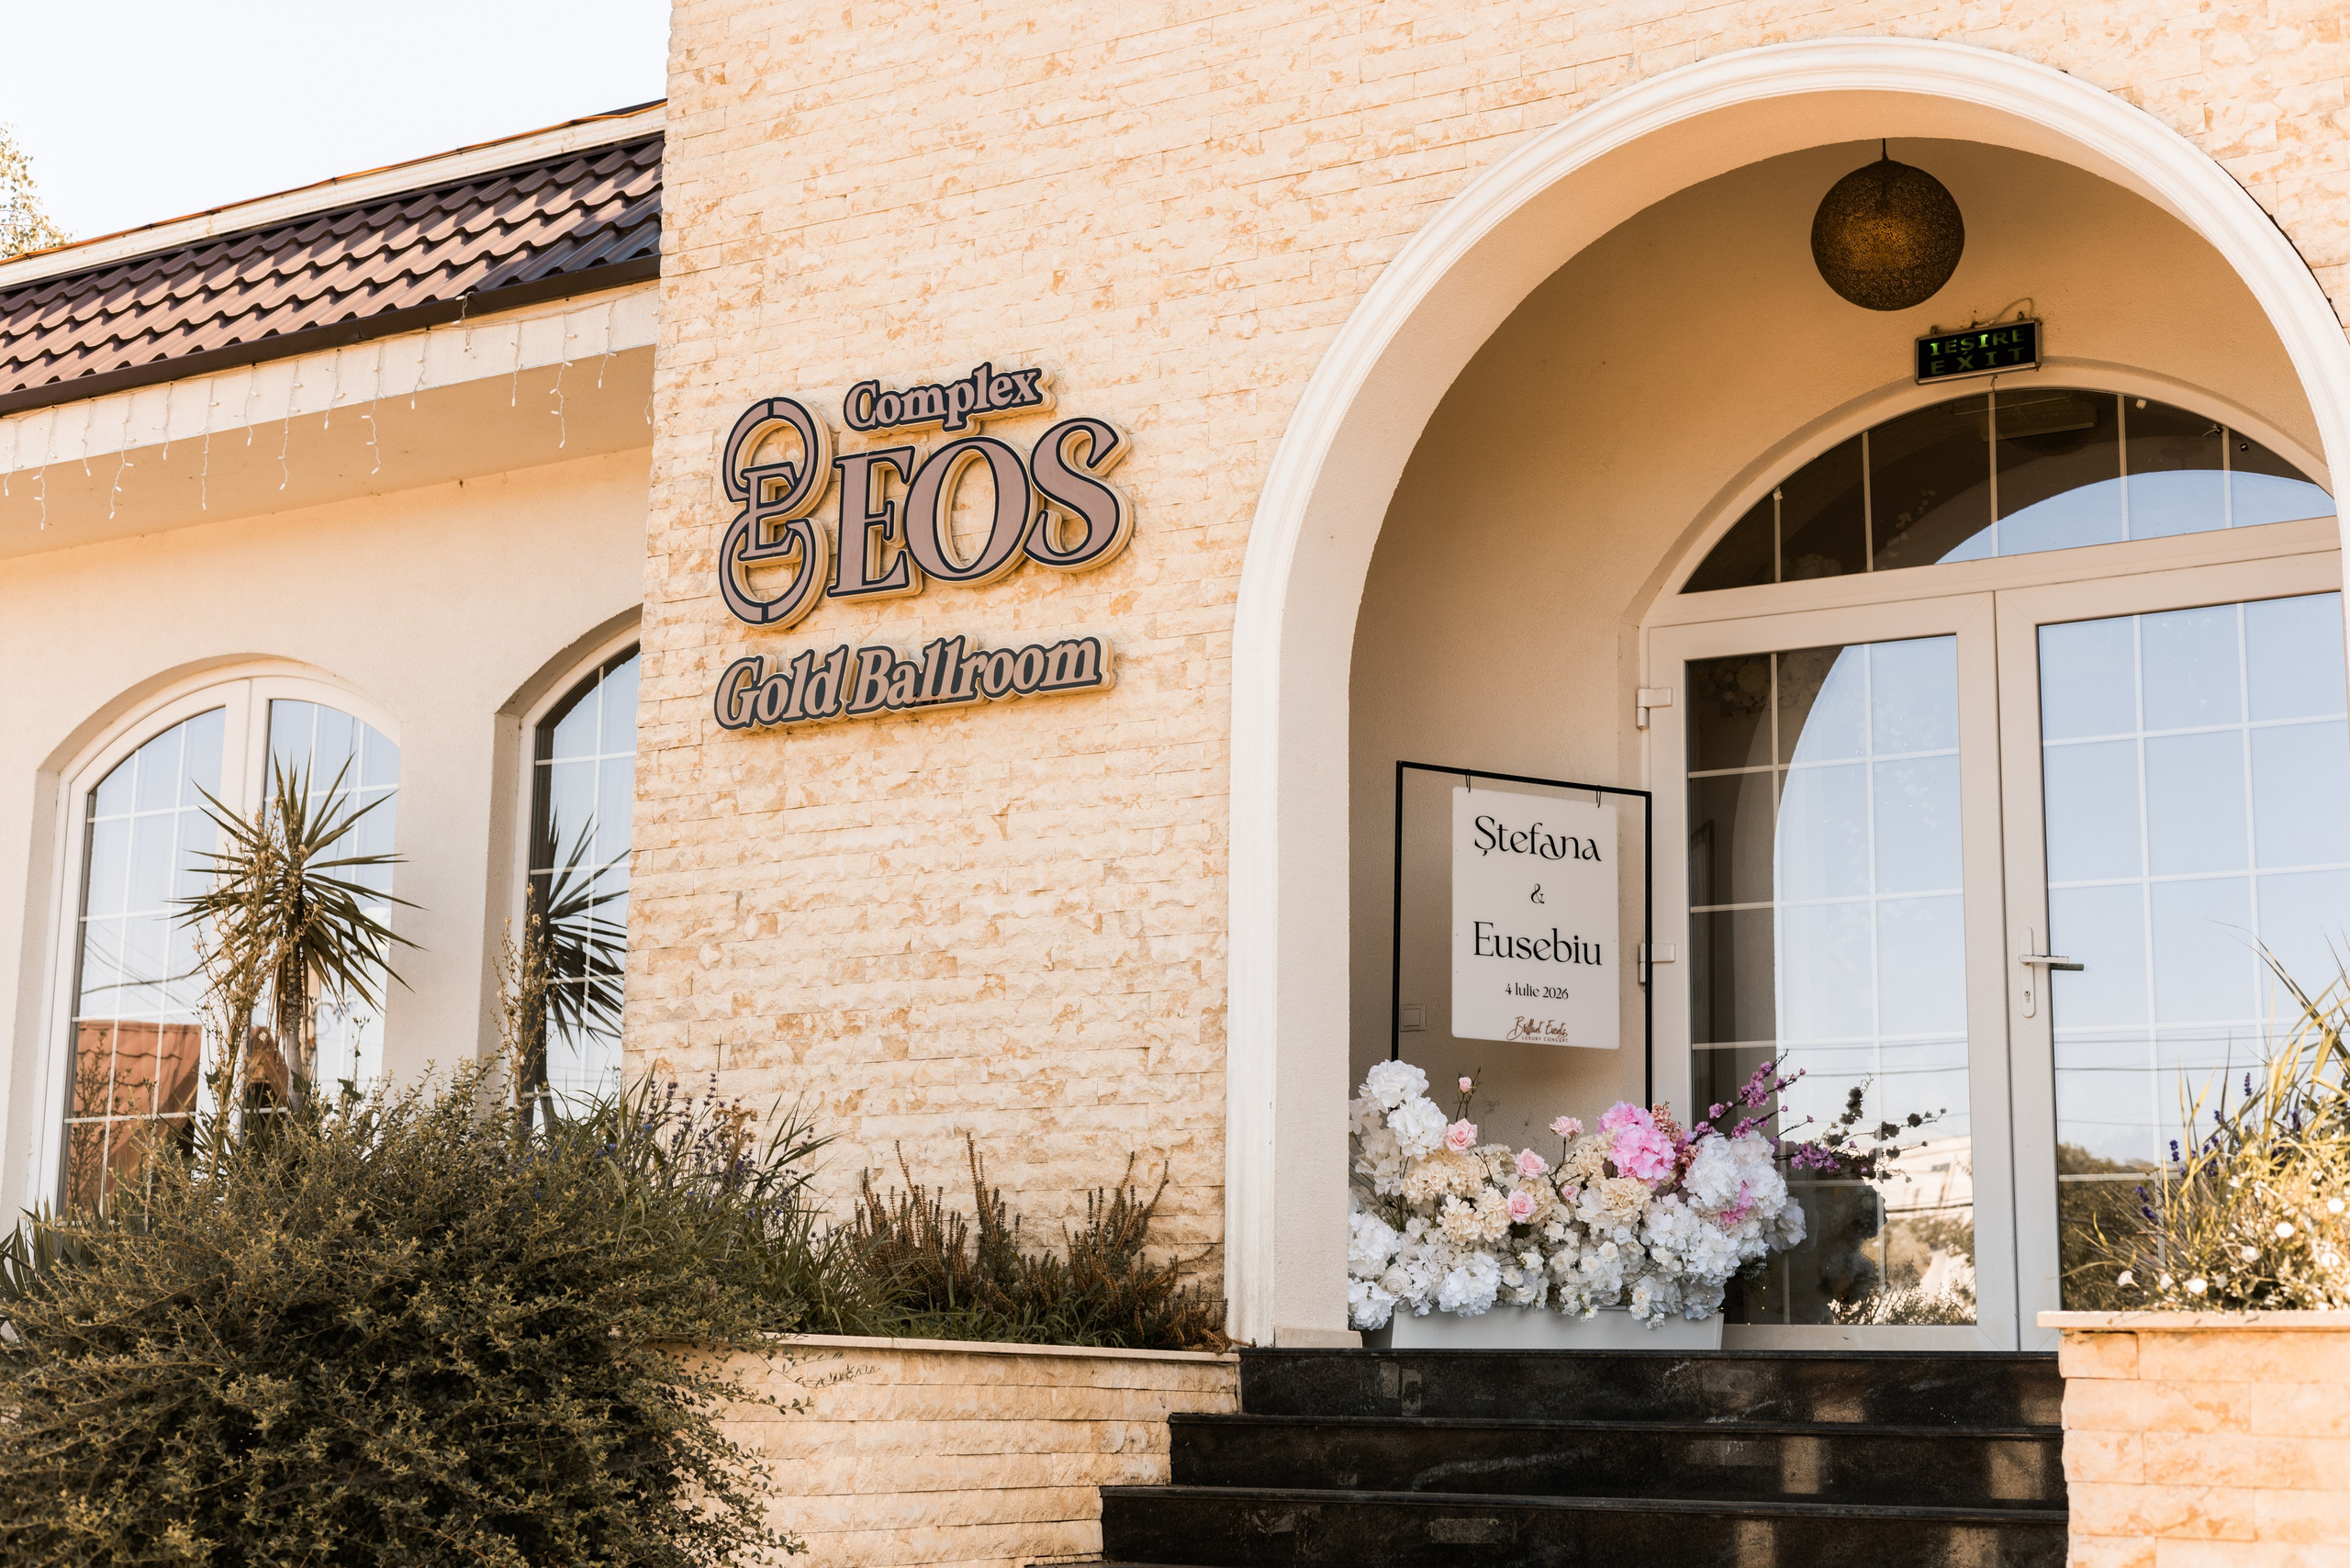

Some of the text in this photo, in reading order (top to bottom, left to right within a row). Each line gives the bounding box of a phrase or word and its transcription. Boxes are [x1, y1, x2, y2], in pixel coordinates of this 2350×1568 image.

[1930, 347, 2025, 375] EXIT
[844, 363, 1043, 431] Complex
[827, 418, 1120, 598] EOS
[715, 635, 1102, 730] Gold Ballroom
[1473, 814, 1603, 862] Ștefana
[1530, 883, 1545, 904] &
[1472, 921, 1603, 966] Eusebiu
[1505, 982, 1569, 1000] 4 Iulie 2026
[1545, 1019, 1569, 1038] Events
